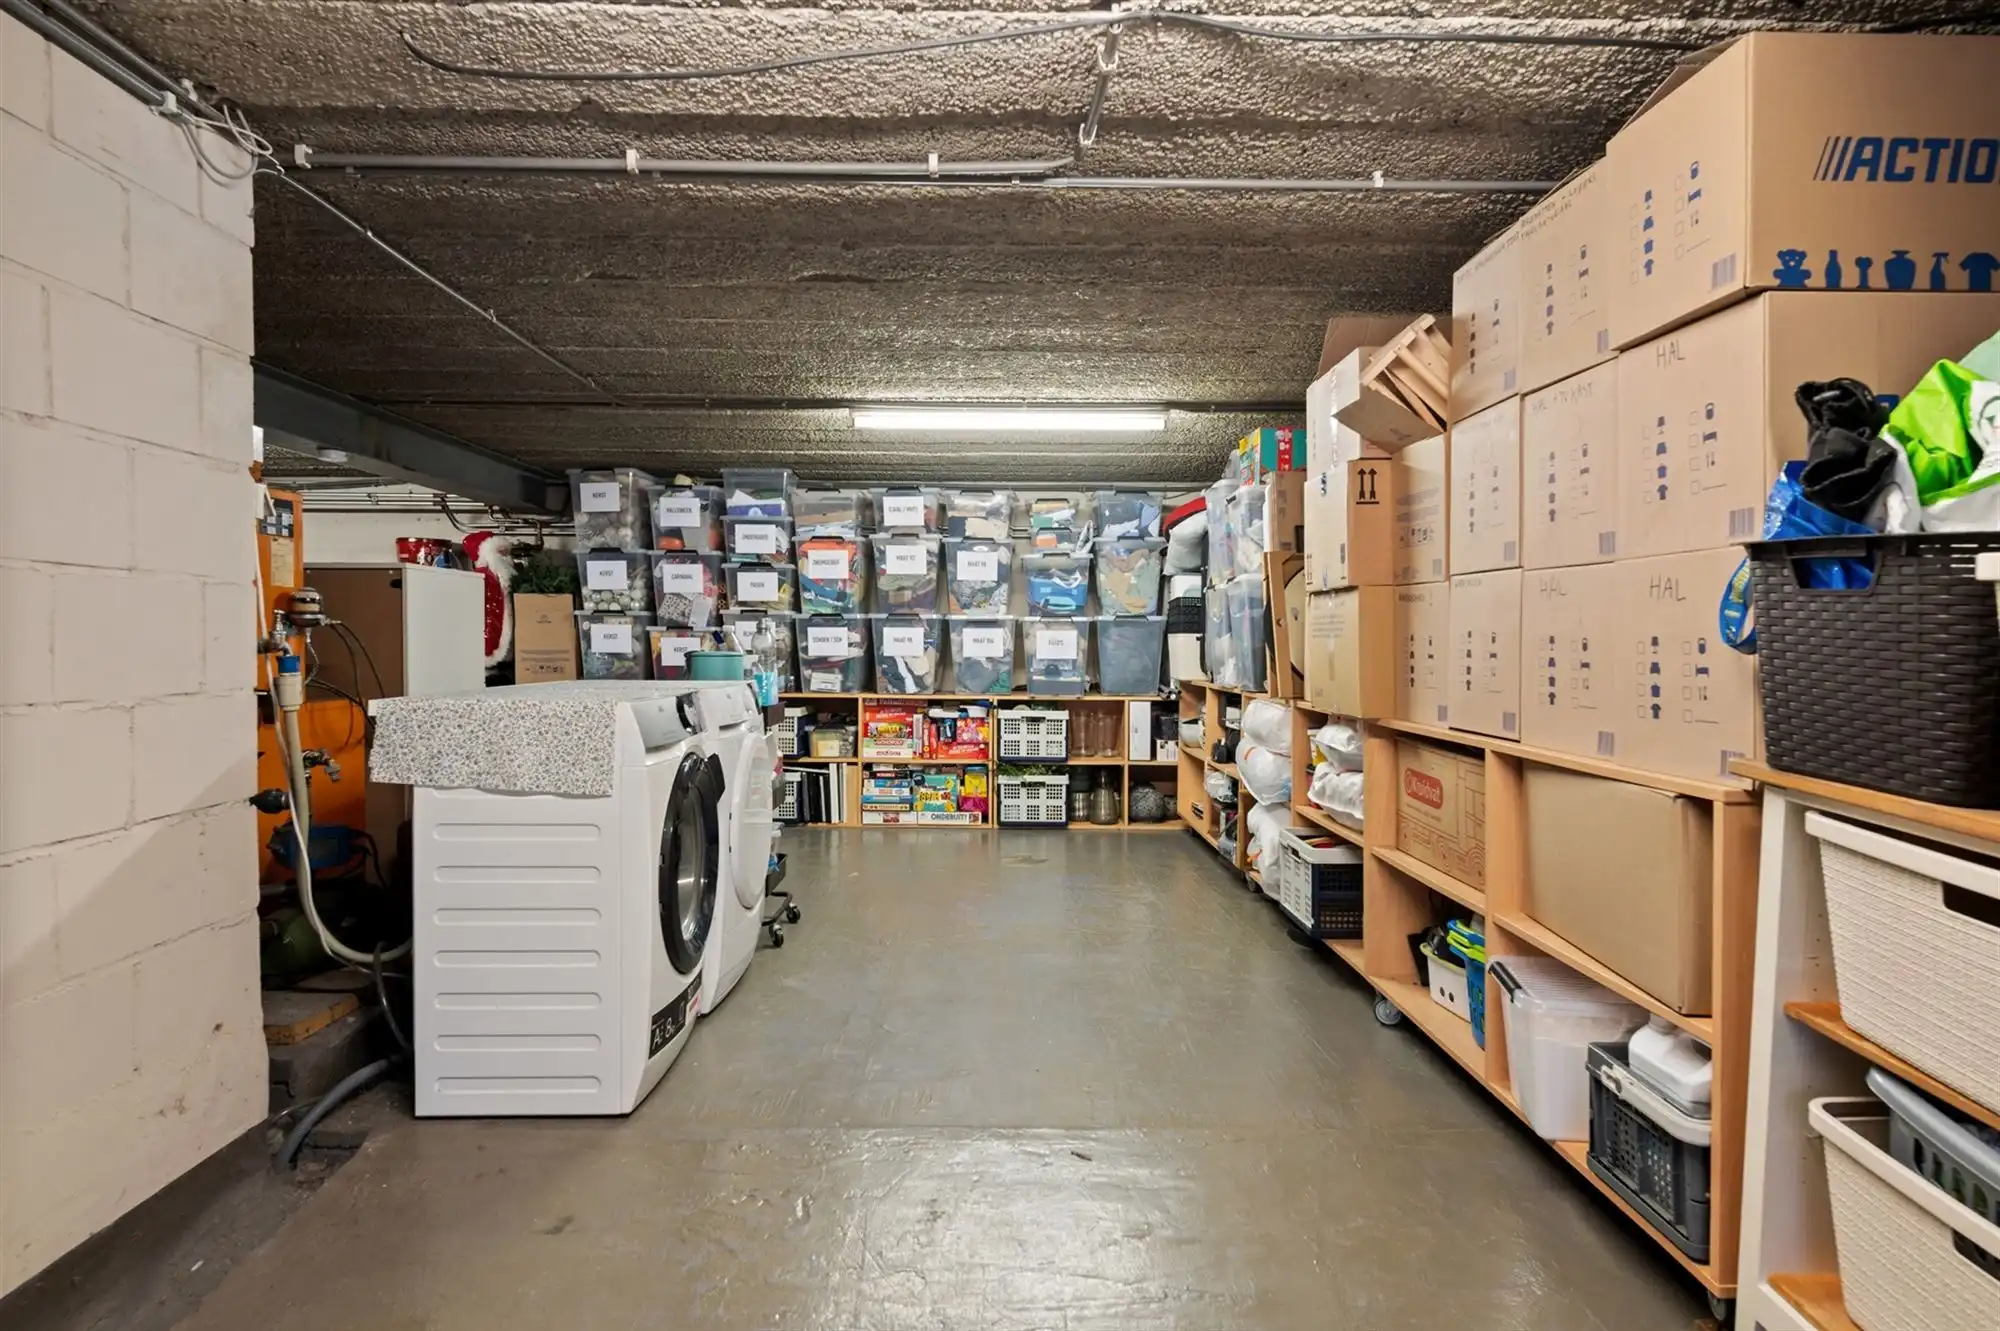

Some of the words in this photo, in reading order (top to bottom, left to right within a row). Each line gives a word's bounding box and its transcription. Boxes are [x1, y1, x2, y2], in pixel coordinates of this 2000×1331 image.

[1843, 136, 2000, 184] ACTIO
[1656, 343, 1685, 369] HAL
[1650, 574, 1687, 602] HAL
